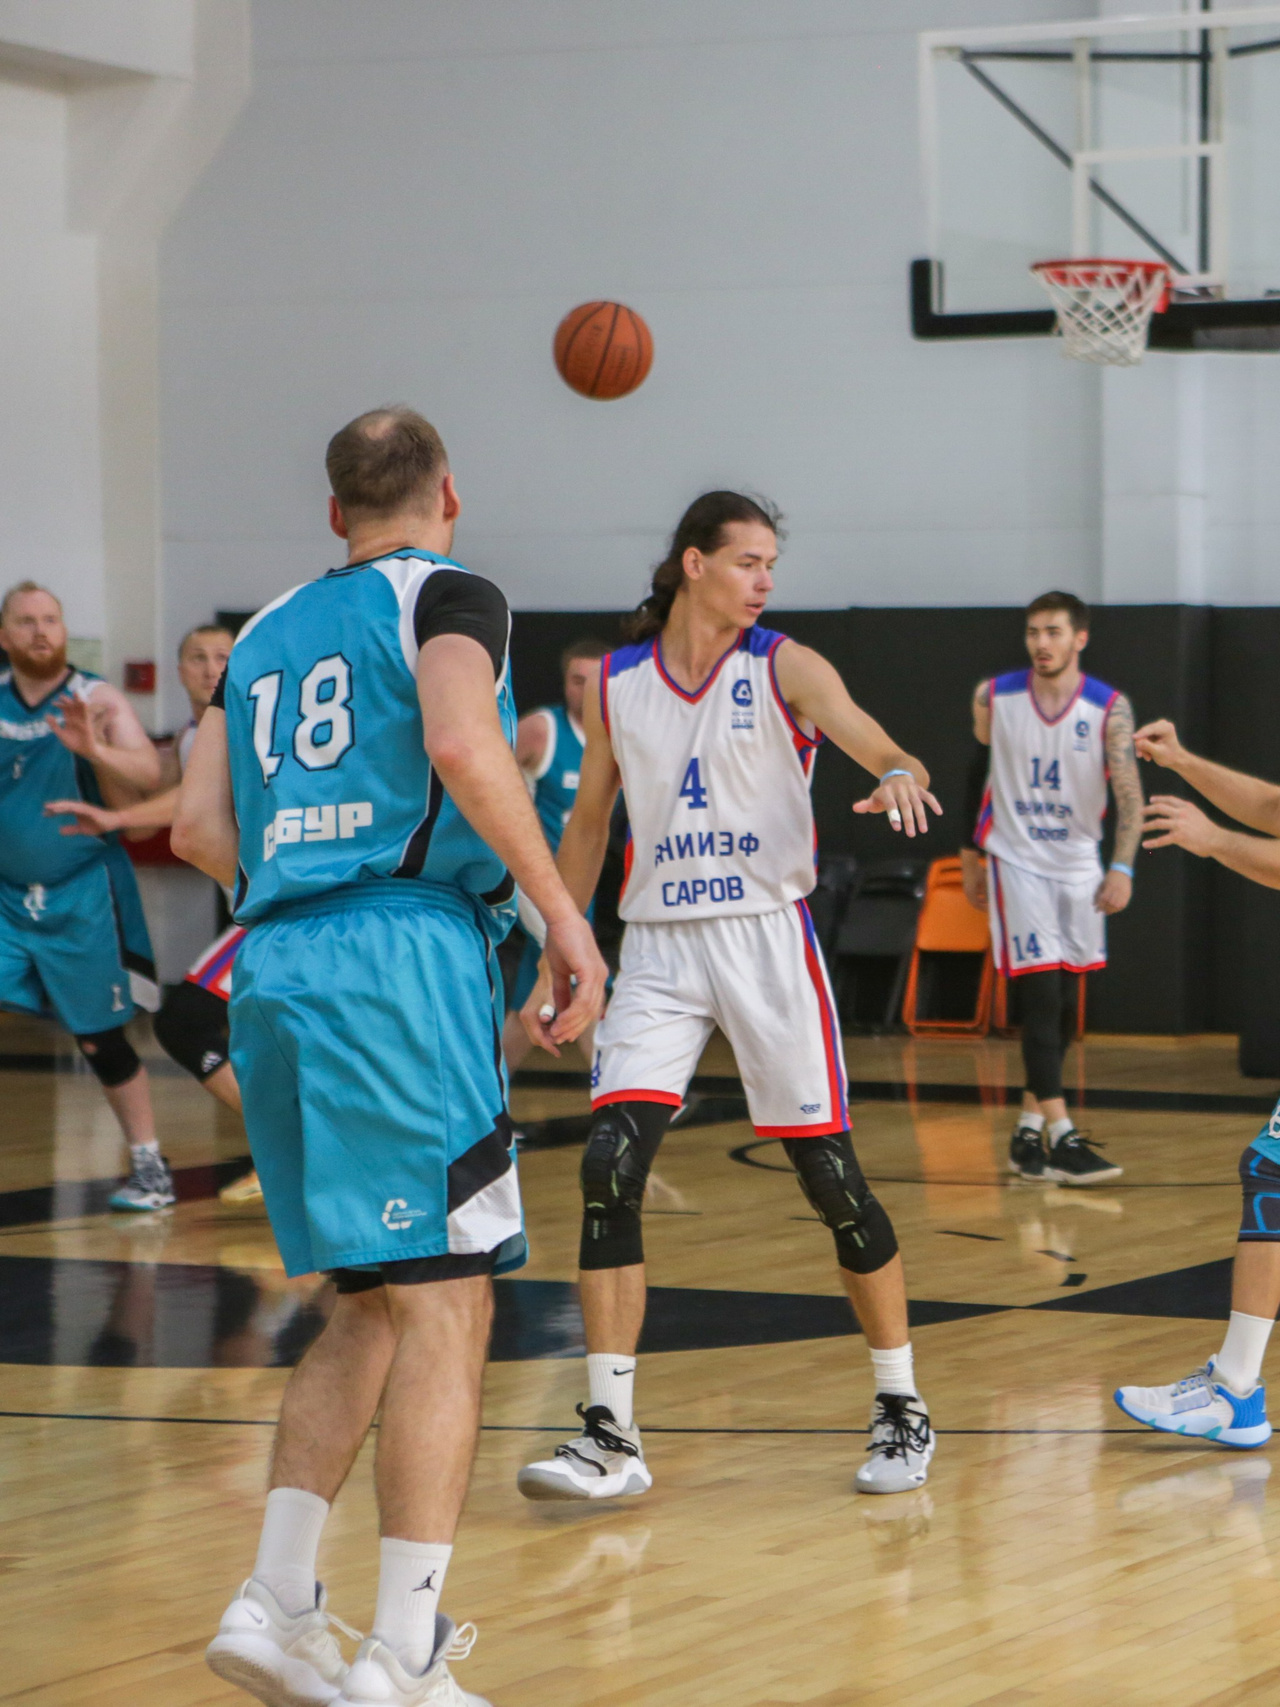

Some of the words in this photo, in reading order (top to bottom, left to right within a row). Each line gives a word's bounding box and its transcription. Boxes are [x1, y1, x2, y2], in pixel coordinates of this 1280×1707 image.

[247, 652, 355, 788] 18
[678, 757, 708, 810] 4
[1030, 757, 1062, 790] 14
[662, 876, 745, 907] САРОВ
[1012, 933, 1042, 963] 14
